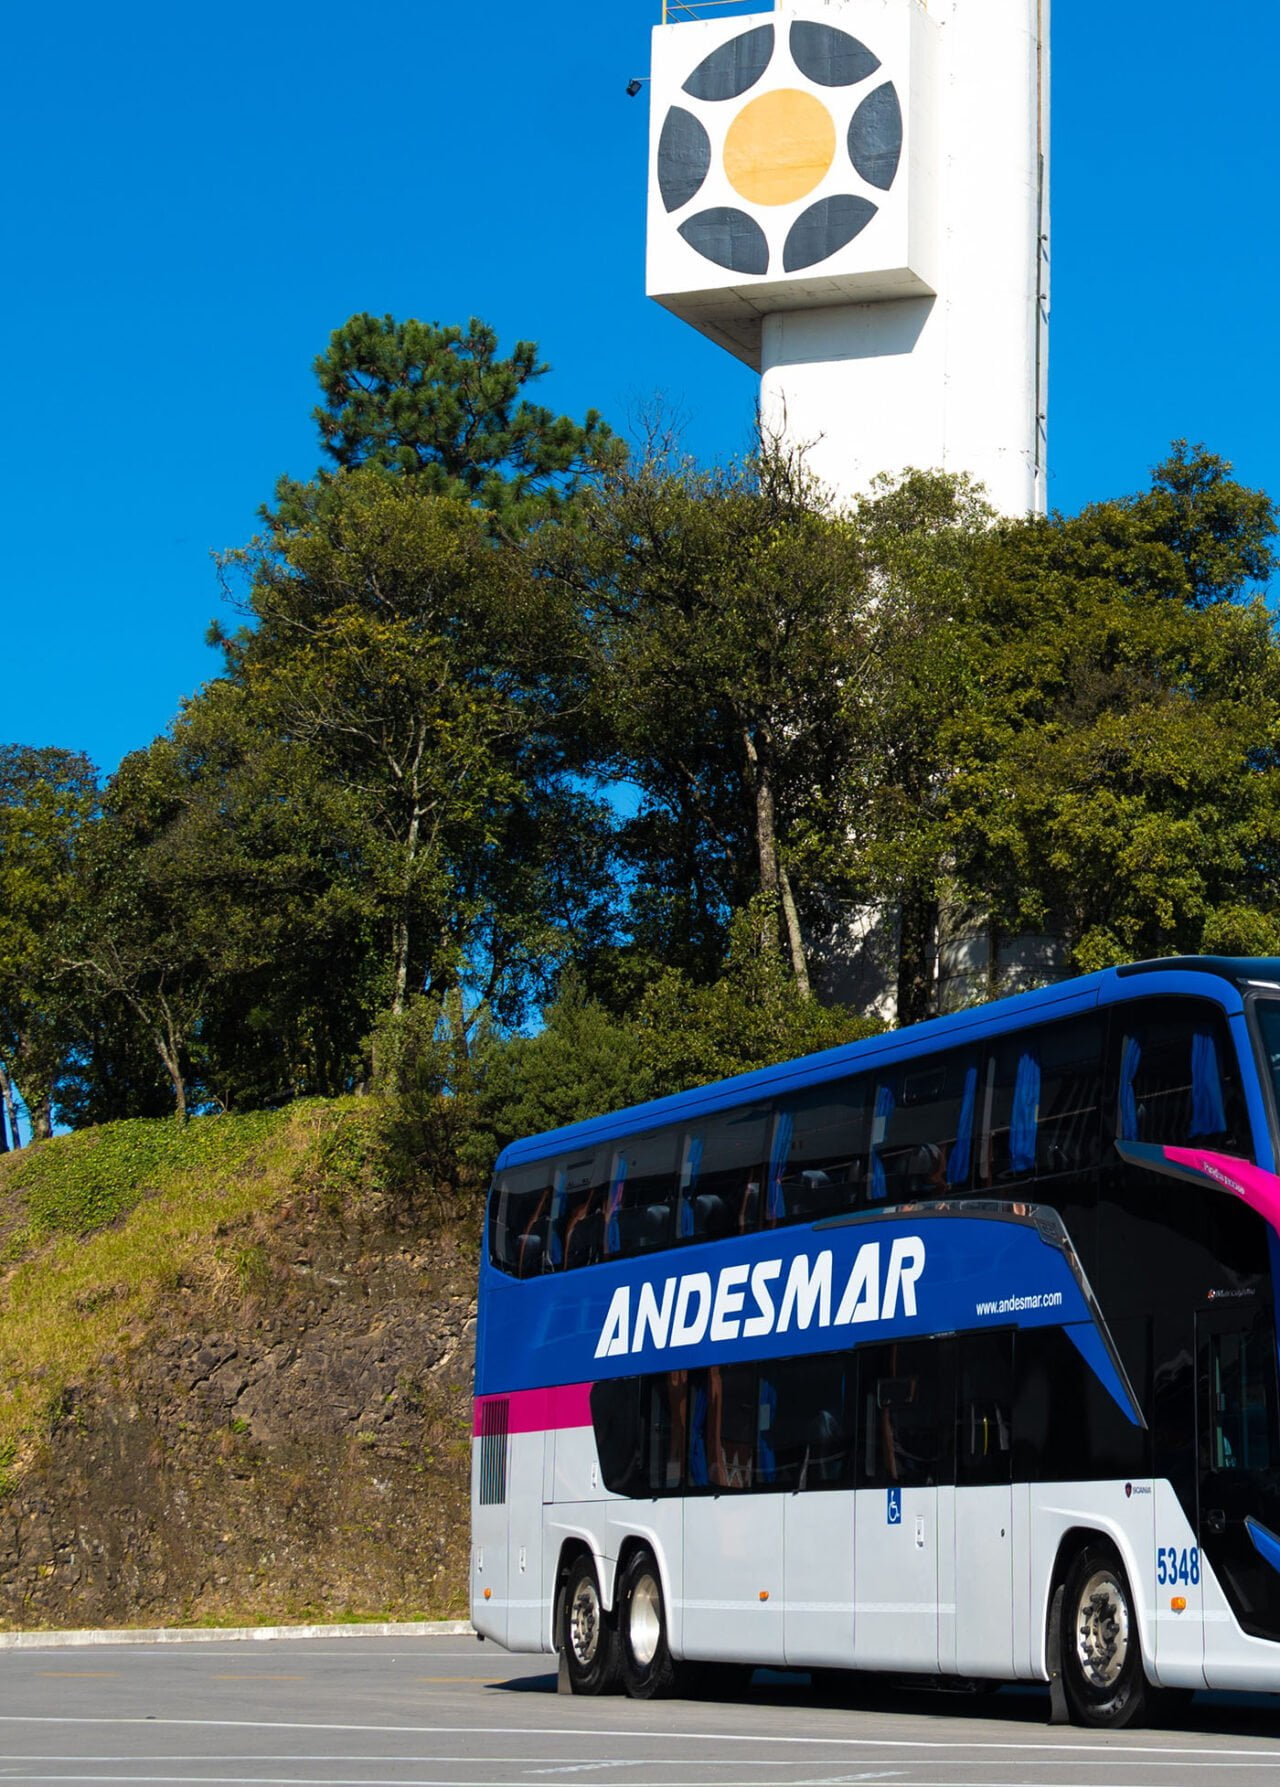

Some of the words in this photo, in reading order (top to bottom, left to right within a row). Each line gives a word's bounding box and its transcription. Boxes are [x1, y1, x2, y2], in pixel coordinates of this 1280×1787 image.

[594, 1236, 925, 1359] ANDESMAR
[976, 1292, 1062, 1316] www.andesmar.com
[1157, 1546, 1200, 1586] 5348
